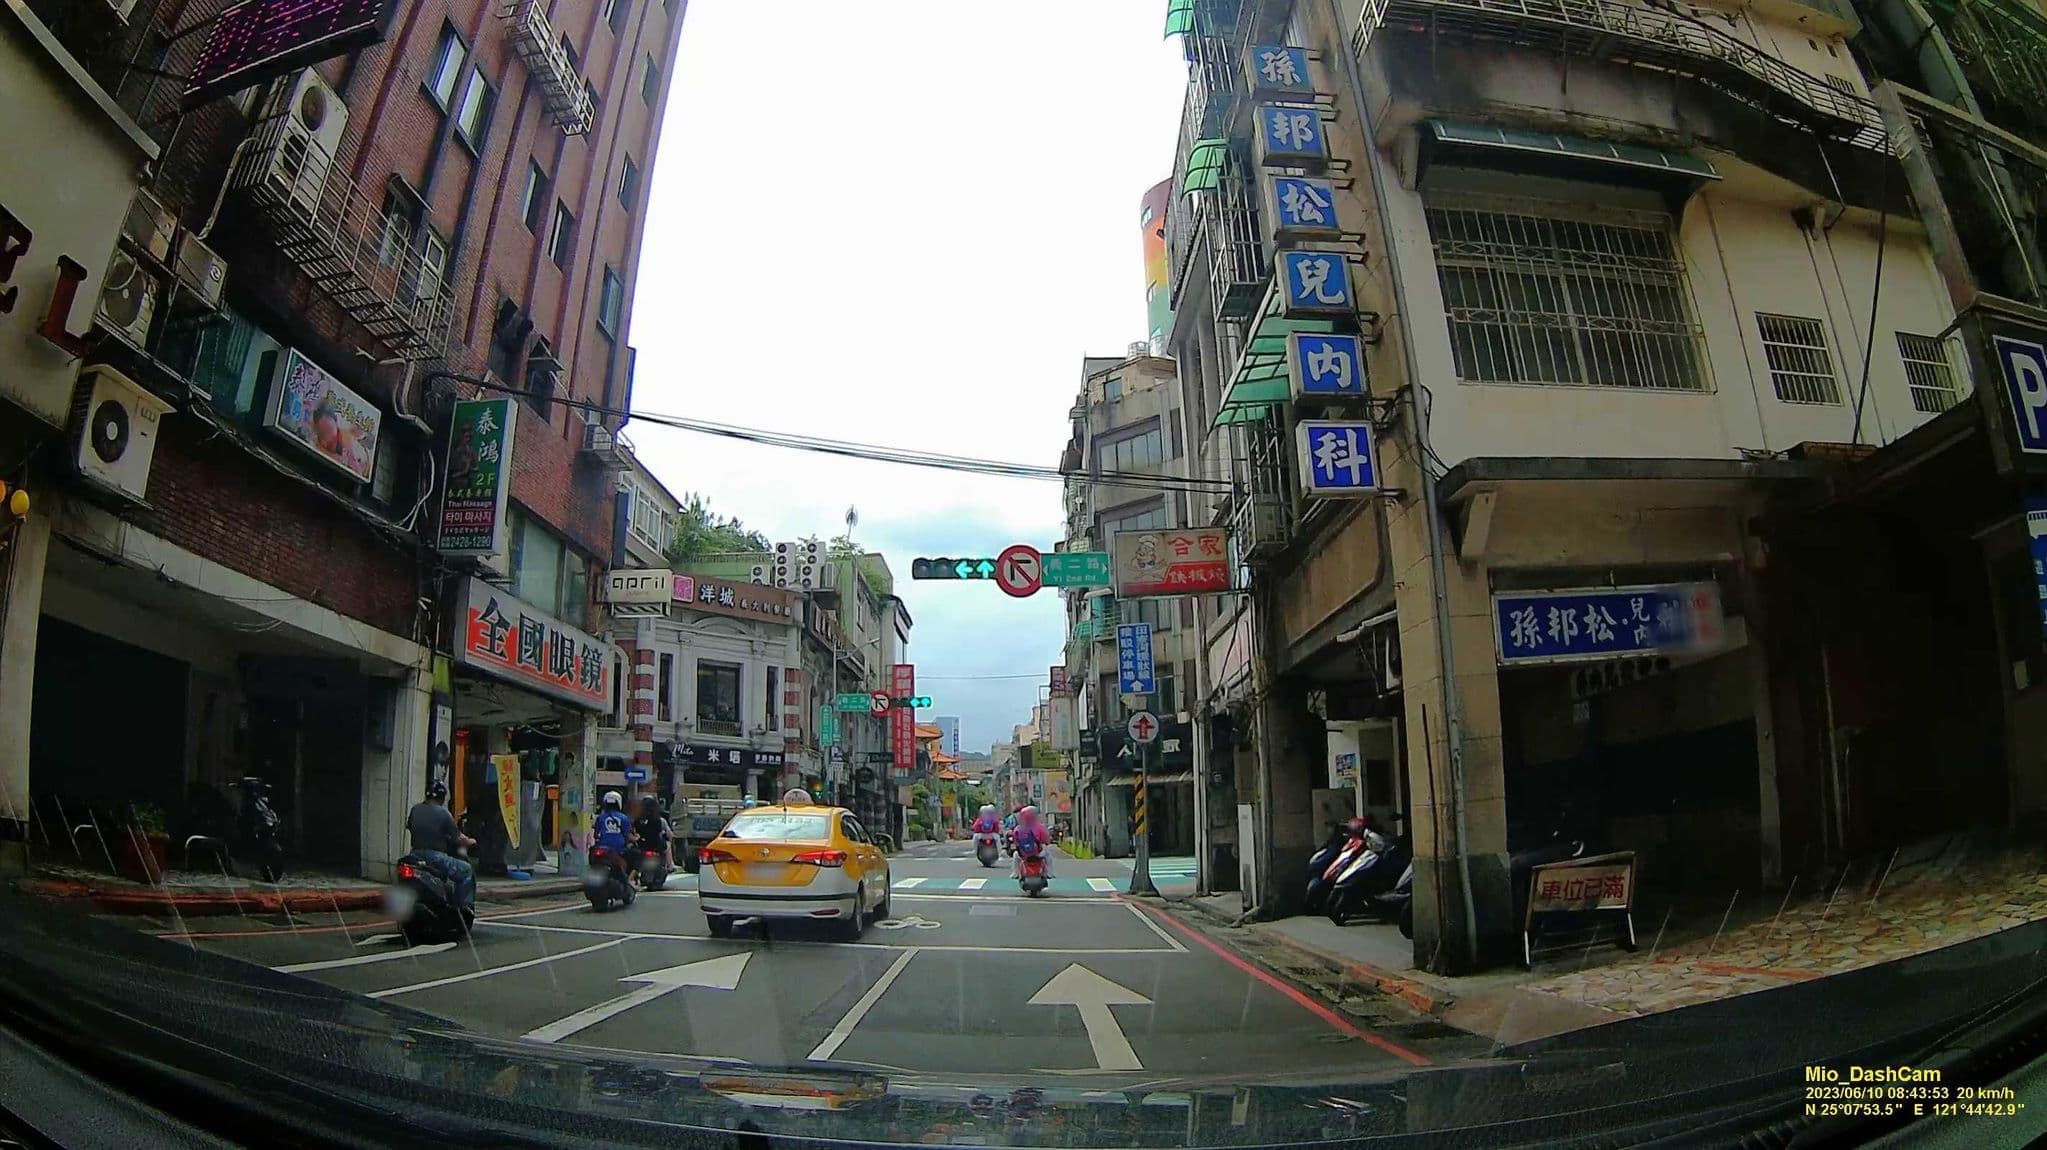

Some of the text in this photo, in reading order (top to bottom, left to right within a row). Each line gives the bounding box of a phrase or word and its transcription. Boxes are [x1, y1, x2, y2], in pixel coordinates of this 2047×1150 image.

[2010, 352, 2047, 439] P
[476, 407, 499, 463] 泰鴻
[476, 473, 496, 486] 2F
[446, 510, 492, 524] 타이 마사지
[1167, 535, 1223, 556] 合家
[612, 576, 664, 590] april
[700, 584, 736, 608] 洋城
[476, 596, 603, 694] 全國眼鏡
